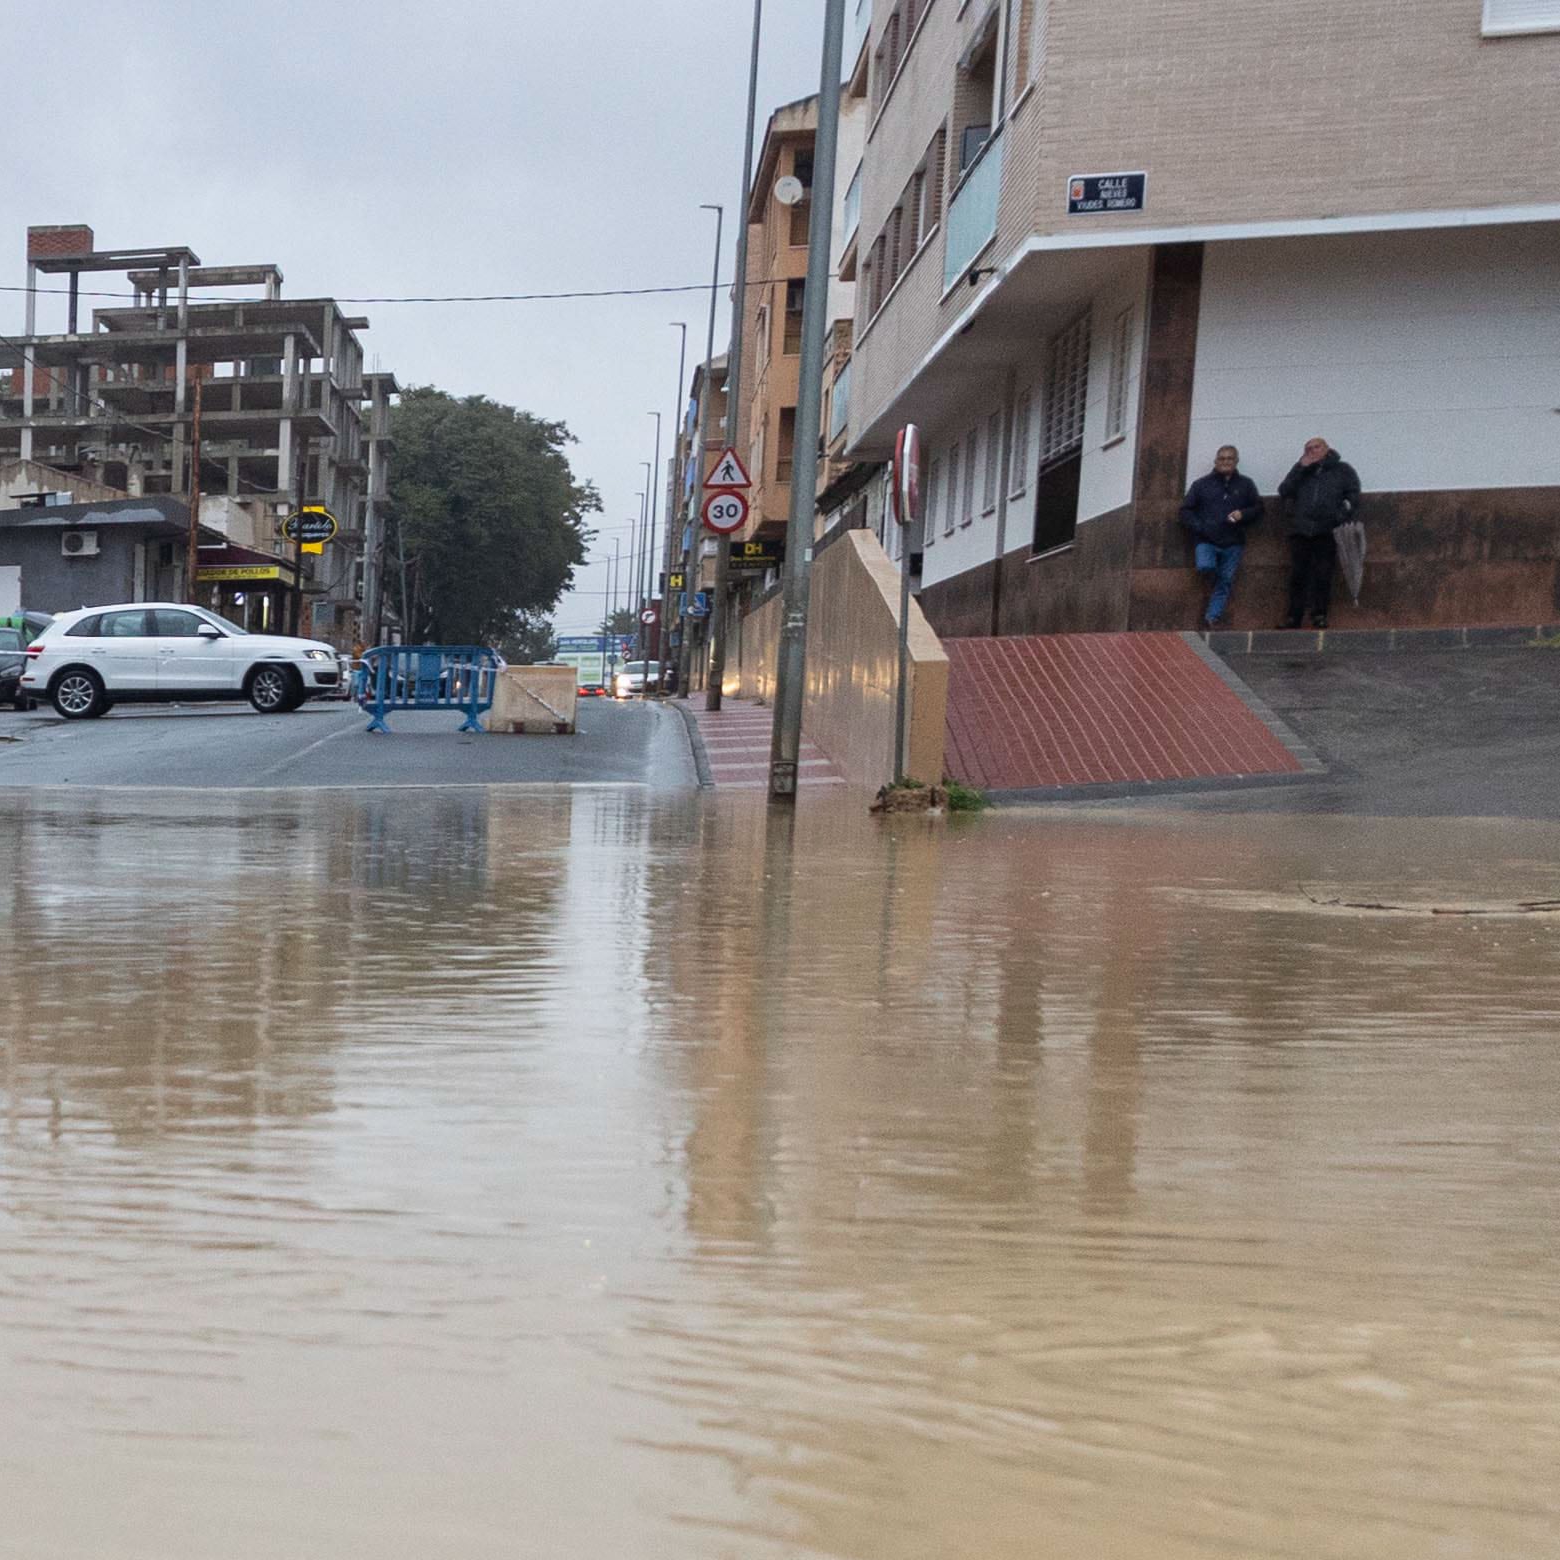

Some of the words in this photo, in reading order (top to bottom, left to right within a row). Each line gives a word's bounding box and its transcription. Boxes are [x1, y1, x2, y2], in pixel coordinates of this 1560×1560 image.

[1098, 178, 1128, 189] CALLE
[1100, 188, 1128, 199] NIEVES
[1106, 198, 1136, 208] ROMERO
[713, 504, 737, 519] 30
[745, 543, 762, 555] DH
